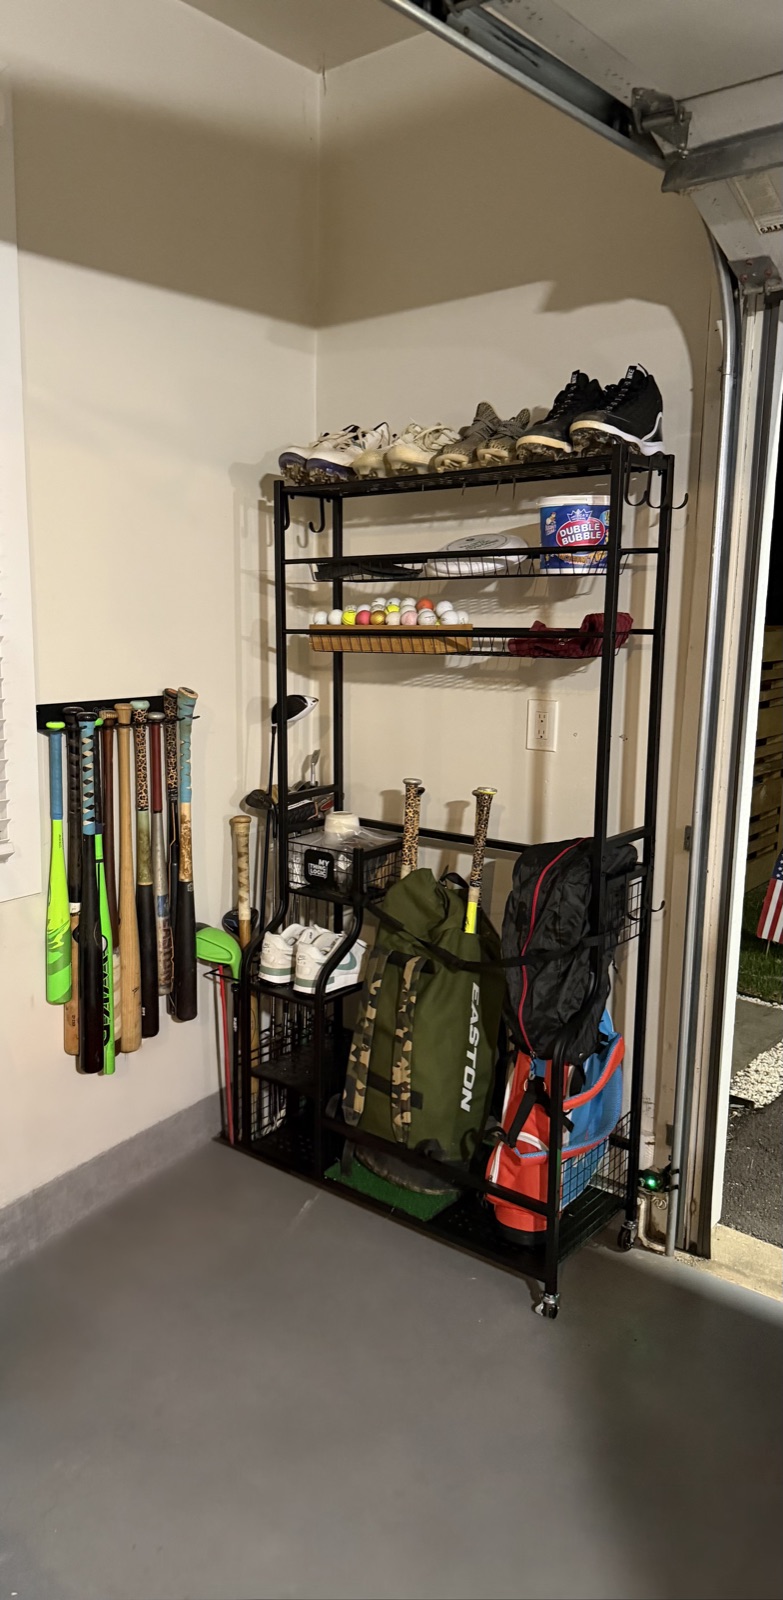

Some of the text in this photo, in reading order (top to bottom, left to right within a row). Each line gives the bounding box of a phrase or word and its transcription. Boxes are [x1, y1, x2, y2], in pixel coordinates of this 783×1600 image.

[560, 523, 600, 537] DUBBLE
[562, 531, 602, 546] BUBBLE
[318, 859, 330, 867] MY
[460, 982, 480, 1112] EASTON
